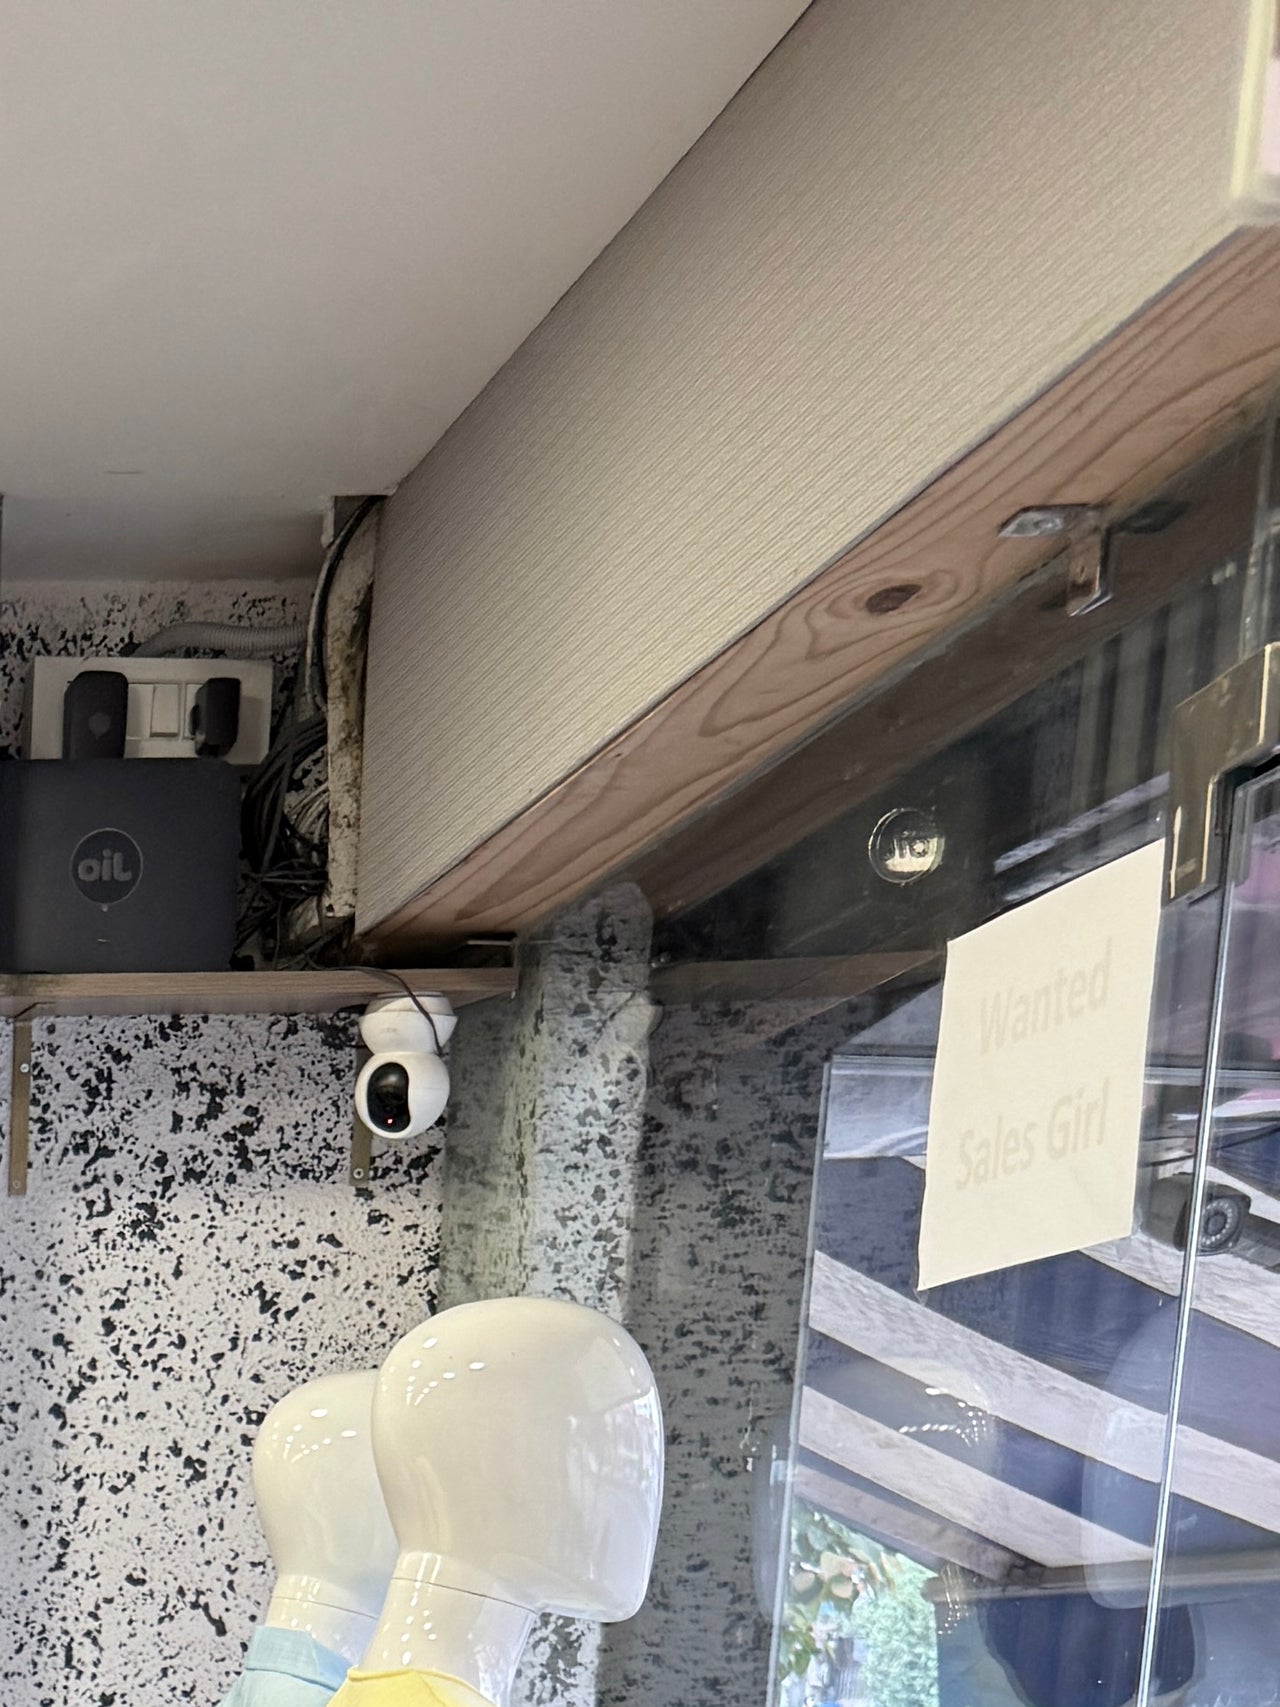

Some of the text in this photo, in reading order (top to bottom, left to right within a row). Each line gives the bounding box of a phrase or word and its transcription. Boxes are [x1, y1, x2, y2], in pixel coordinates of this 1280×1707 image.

[978, 936, 1113, 1056] Wanted
[955, 1078, 1110, 1190] Sales Girl
